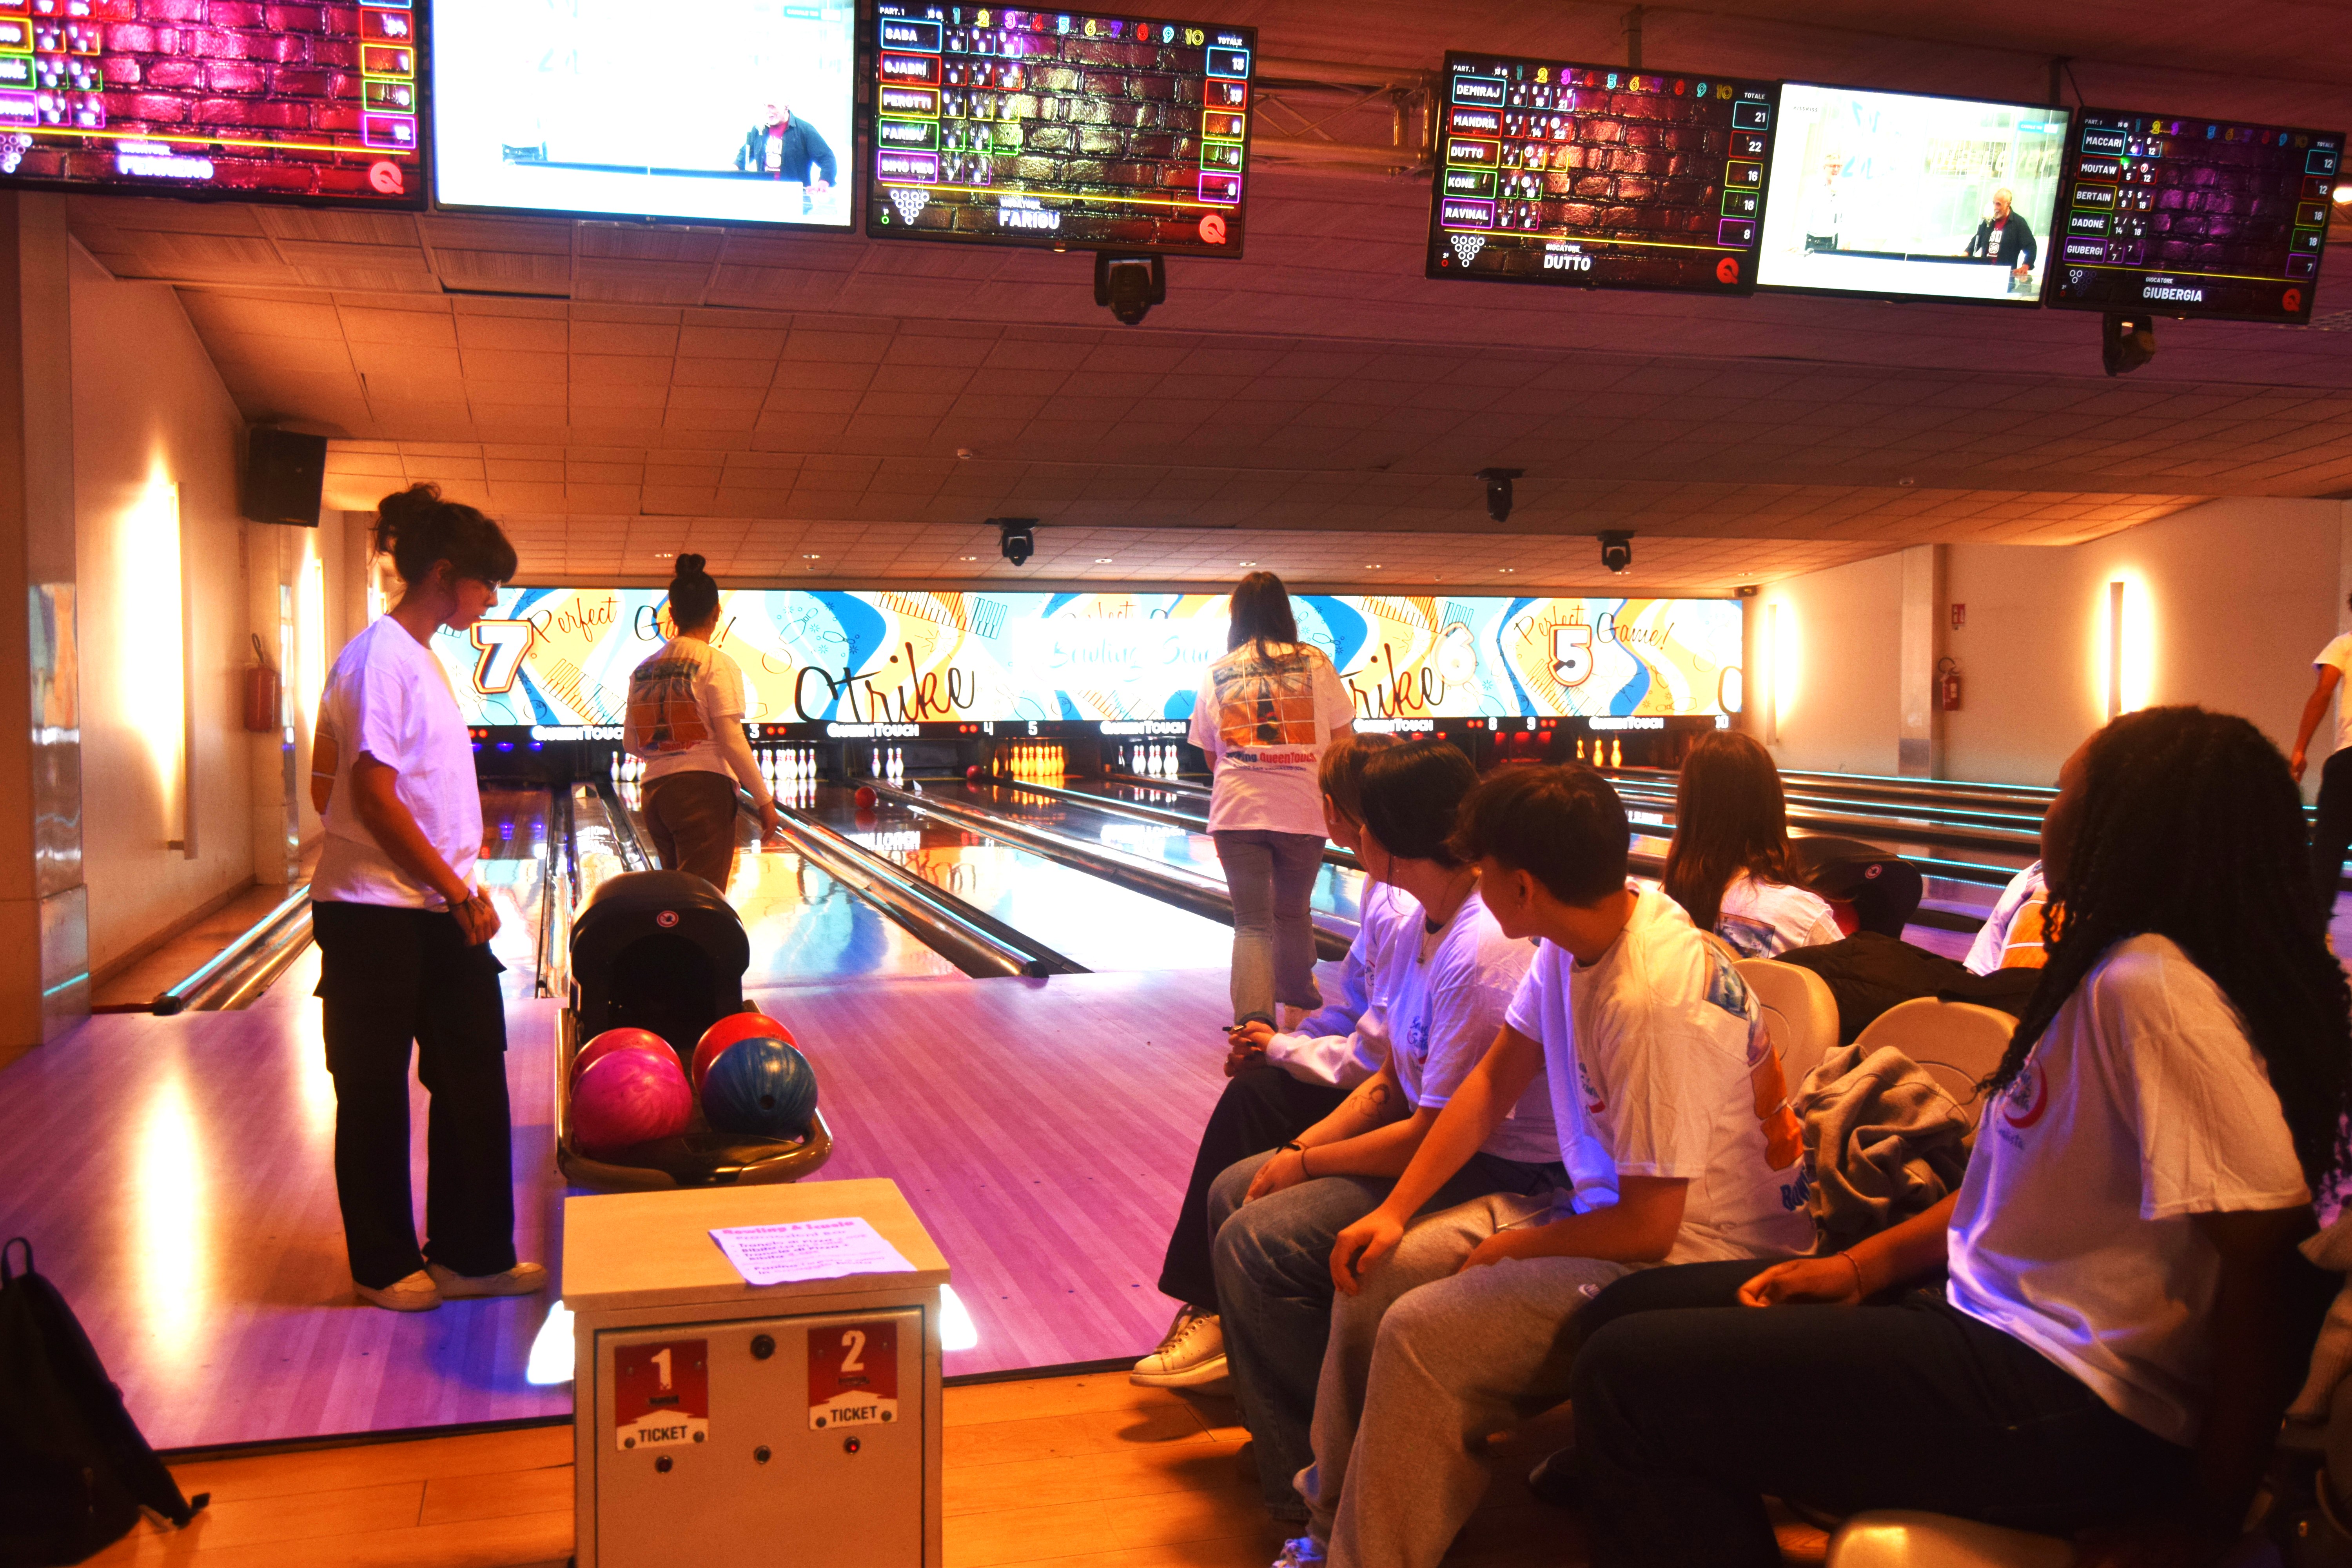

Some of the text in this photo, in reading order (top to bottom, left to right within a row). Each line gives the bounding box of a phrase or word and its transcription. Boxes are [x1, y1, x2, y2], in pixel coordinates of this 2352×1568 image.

[880, 7, 900, 15] PART.
[953, 7, 960, 24] 1
[978, 9, 990, 27] 2
[1005, 12, 1016, 29] 3
[1031, 15, 1043, 32] 4
[1058, 17, 1070, 34] 5
[1084, 20, 1096, 36] 6
[1111, 22, 1123, 38] 7
[1138, 24, 1149, 41] 8
[1162, 27, 1174, 43] 9
[1185, 29, 1204, 45] 10
[1218, 37, 1242, 47] TOTALE
[885, 28, 918, 42] SABA
[985, 64, 991, 74] 7
[1232, 58, 1244, 71] 13
[1517, 65, 1523, 80] 1
[1537, 68, 1548, 83] 2
[1561, 69, 1571, 85] 3
[1584, 72, 1593, 87] 4
[1607, 74, 1617, 89] 5
[1630, 76, 1639, 91] 6
[1653, 78, 1663, 93] 7
[1675, 80, 1684, 95] 8
[1697, 82, 1707, 97] 9
[1717, 84, 1733, 100] 10
[1230, 90, 1242, 102] 13
[1456, 84, 1500, 98] DEMIRAJ
[884, 94, 931, 109] PEROTTI
[1558, 100, 1568, 109] 21
[1454, 115, 1497, 129] MANDRIL
[1755, 112, 1765, 123] 21
[1510, 127, 1565, 140] 7 14 22
[2151, 121, 2161, 134] 2
[2207, 125, 2216, 140] 5
[2225, 129, 2234, 141] 6
[2279, 133, 2287, 147] 9
[1749, 142, 1762, 152] 22
[2086, 136, 2122, 147] MACCARI
[1451, 145, 1543, 159] DUTTO 7 2
[882, 160, 909, 173] SIMO
[1508, 157, 1514, 165] 7
[2324, 159, 2333, 169] 12
[2081, 163, 2117, 175] MOUTAW
[1748, 171, 1758, 181] 16
[1448, 178, 1475, 189] KONE
[2319, 185, 2328, 194] 12
[2076, 191, 2111, 201] BERTAIN
[1744, 200, 1754, 211] 18
[1000, 211, 1059, 230] FARIGU
[1445, 208, 1489, 220] RAVINAL
[2314, 211, 2322, 221] 18
[2072, 218, 2104, 229] DADONE
[1744, 229, 1750, 240] 8
[1546, 244, 1580, 253] GIOCATORE
[2309, 237, 2317, 247] 18
[2067, 245, 2103, 256] GIUBERGI
[1544, 255, 1591, 271] DUTTO
[2307, 263, 2312, 272] 7
[2143, 287, 2202, 302] GIUBERGIA
[527, 597, 620, 643] Perfect
[1597, 612, 1674, 650] Game!
[470, 619, 534, 694] 7
[1430, 622, 1476, 686] 6
[1548, 624, 1592, 687] 5
[1340, 643, 1445, 718] rike
[1028, 721, 1038, 735] 5
[1488, 717, 1497, 731] 8
[1527, 717, 1535, 730] 9
[1715, 715, 1729, 728] 10
[750, 724, 760, 738] 3
[984, 721, 994, 735] 4
[1259, 752, 1317, 764] QueenTouch
[841, 1330, 866, 1372] 2
[651, 1348, 672, 1390] 1
[830, 1405, 878, 1423] TICKET
[638, 1425, 688, 1443] TICKET
